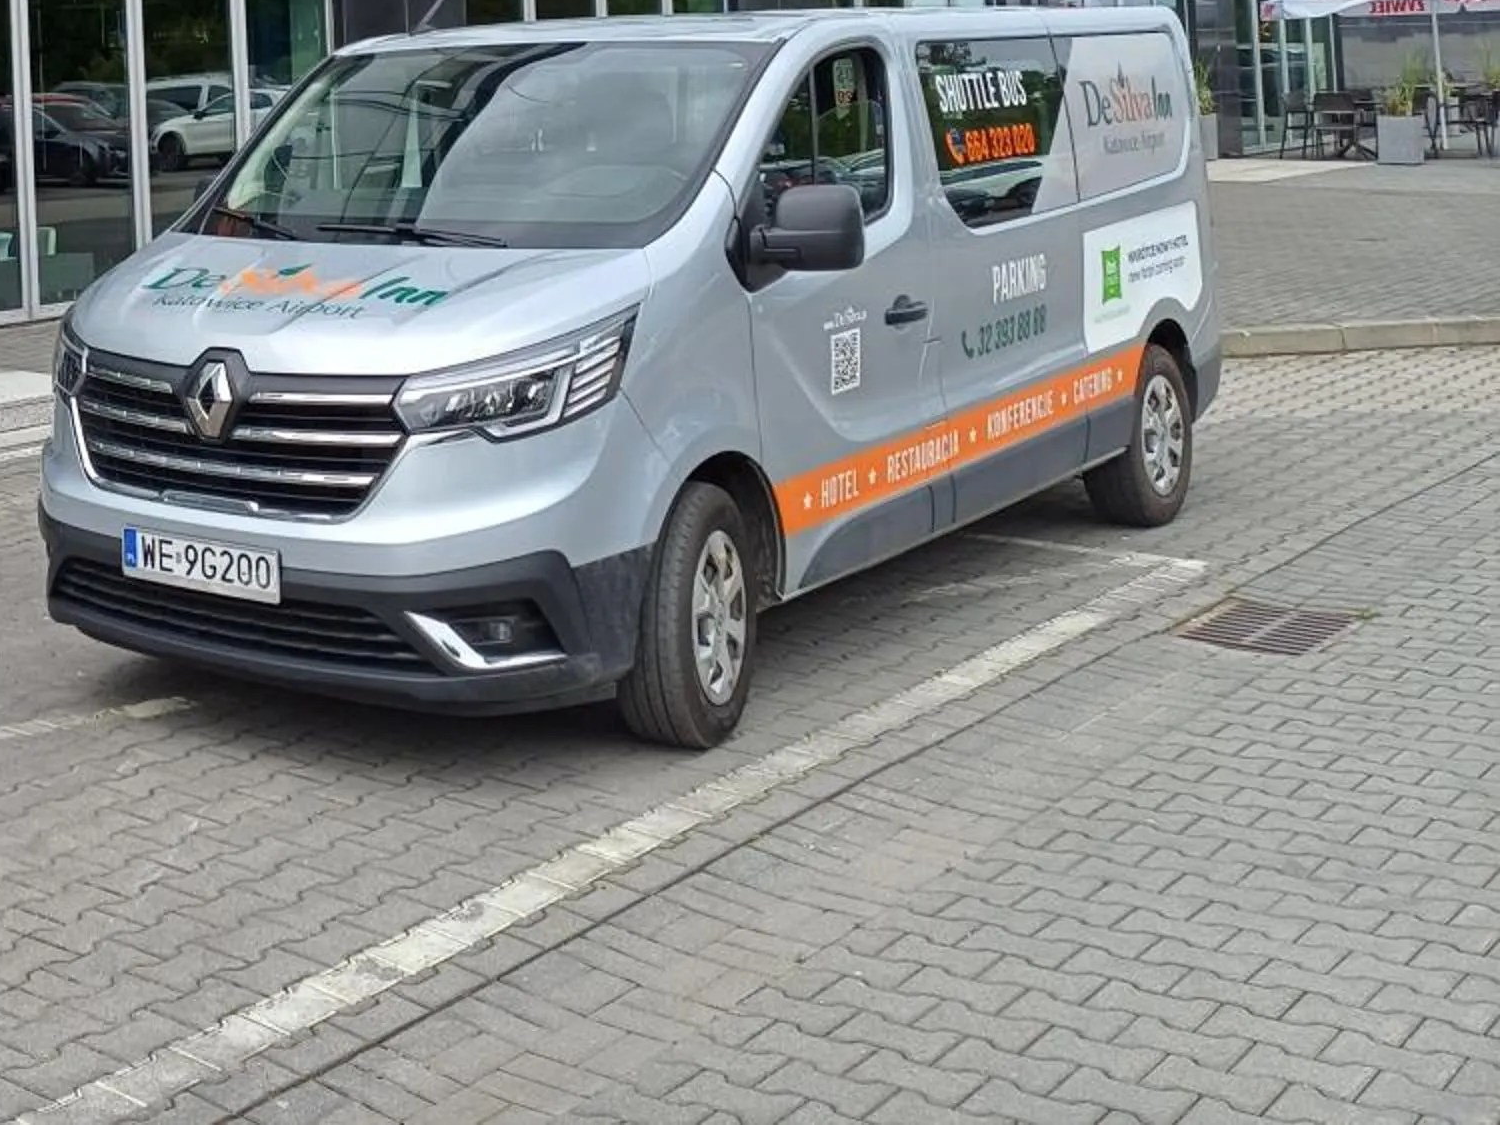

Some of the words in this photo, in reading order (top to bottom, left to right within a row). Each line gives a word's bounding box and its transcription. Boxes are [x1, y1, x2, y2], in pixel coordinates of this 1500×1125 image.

[935, 72, 1000, 113] SHUTTLE
[996, 70, 1028, 107] BUS
[1078, 74, 1152, 127] DeSilva
[359, 276, 451, 306] Inn
[992, 253, 1047, 305] PARKING
[820, 467, 860, 508] HOTEL
[141, 534, 173, 573] WE
[184, 544, 271, 589] 9G200
